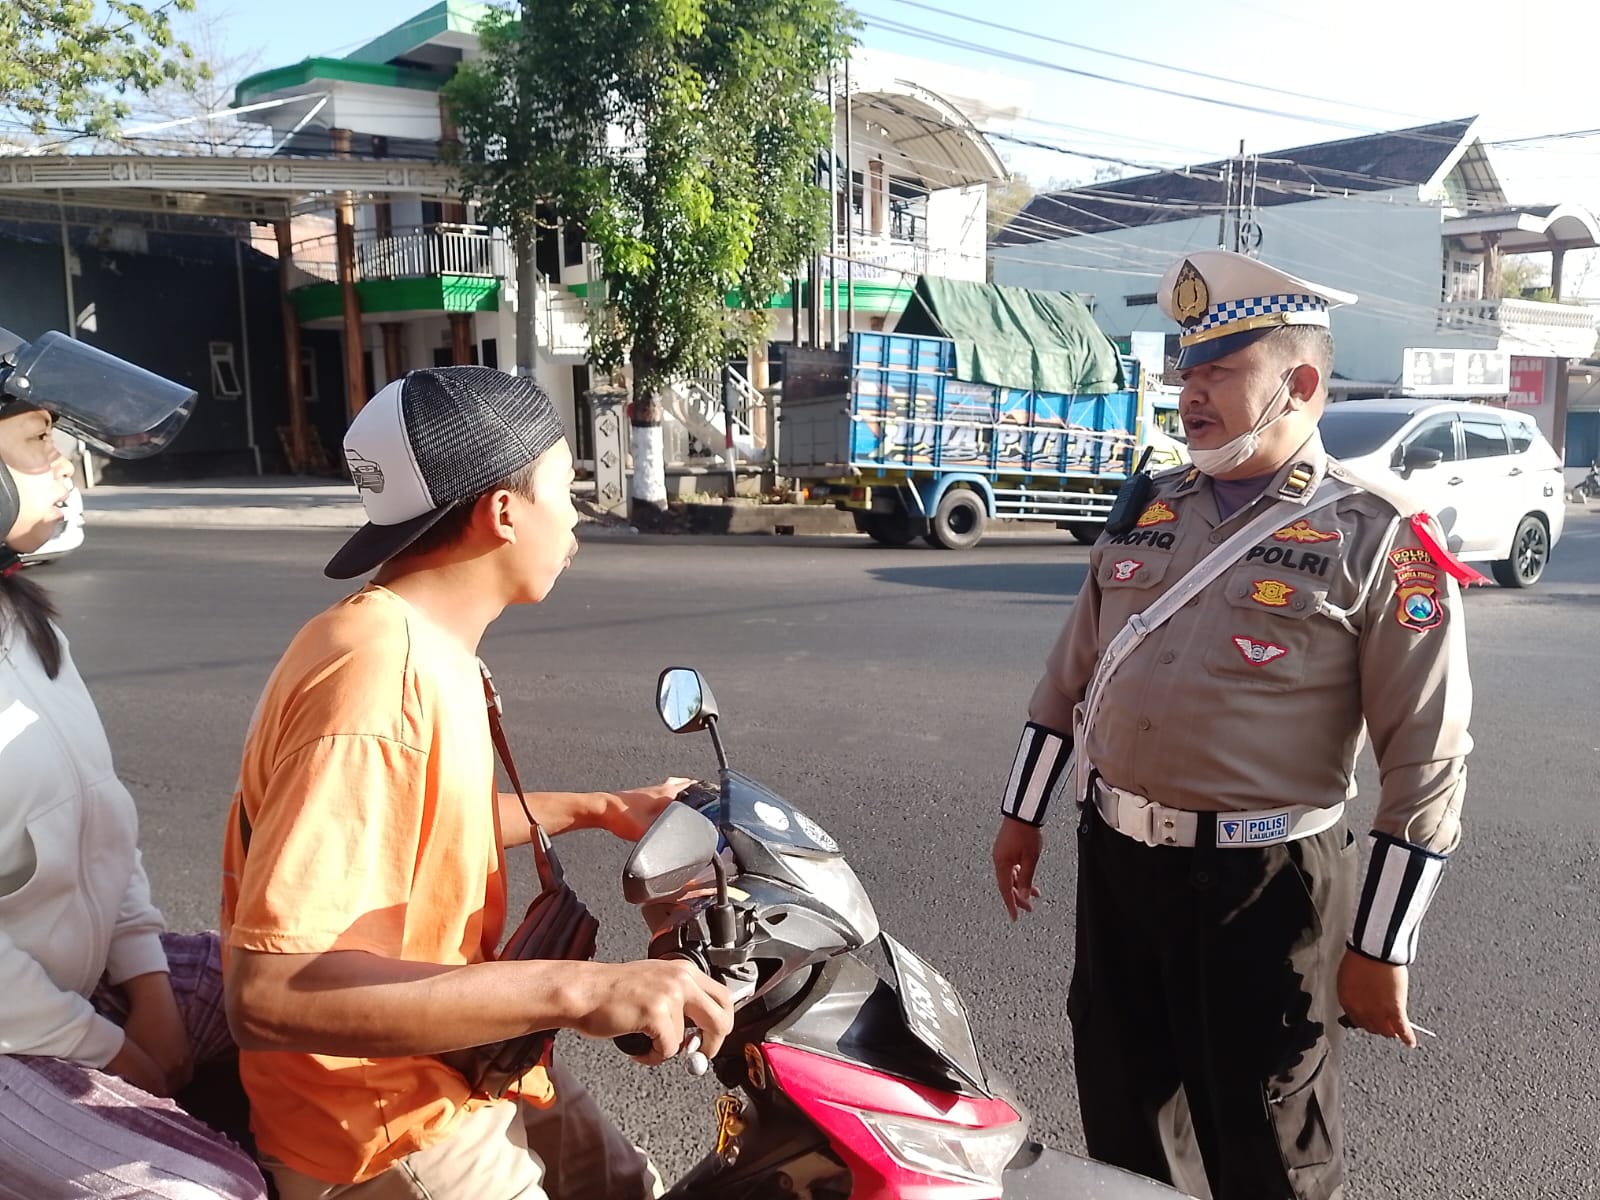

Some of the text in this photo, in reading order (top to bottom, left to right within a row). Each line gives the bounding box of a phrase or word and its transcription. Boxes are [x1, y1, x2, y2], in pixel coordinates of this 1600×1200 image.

[1246, 545, 1329, 576] POLRI
[1393, 549, 1428, 562] POLRI
[1249, 816, 1285, 832] POLISI
